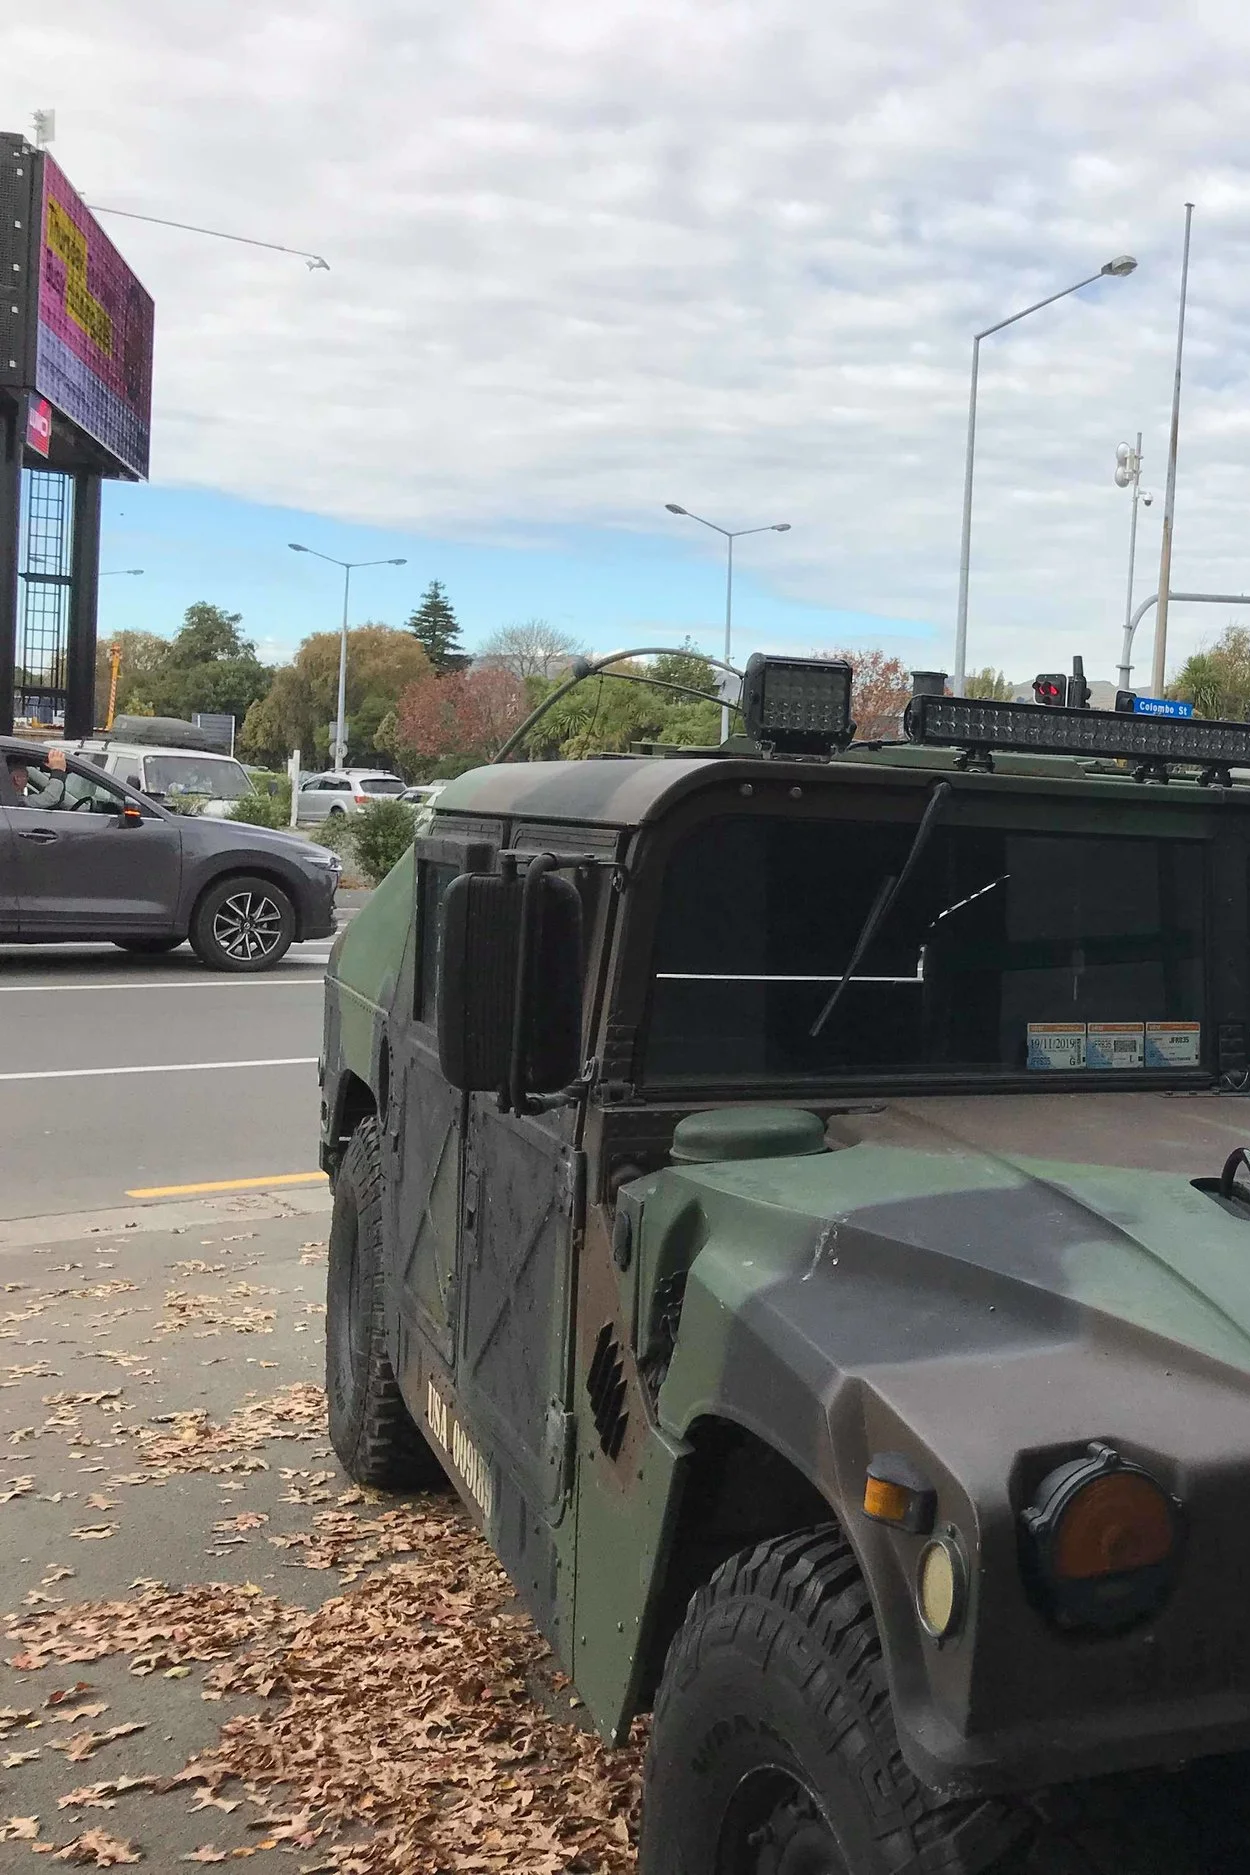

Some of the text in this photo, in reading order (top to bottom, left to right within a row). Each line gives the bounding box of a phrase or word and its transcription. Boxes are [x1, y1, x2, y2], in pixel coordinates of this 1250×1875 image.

[1139, 701, 1188, 716] Colombo St
[427, 1381, 448, 1452] USA
